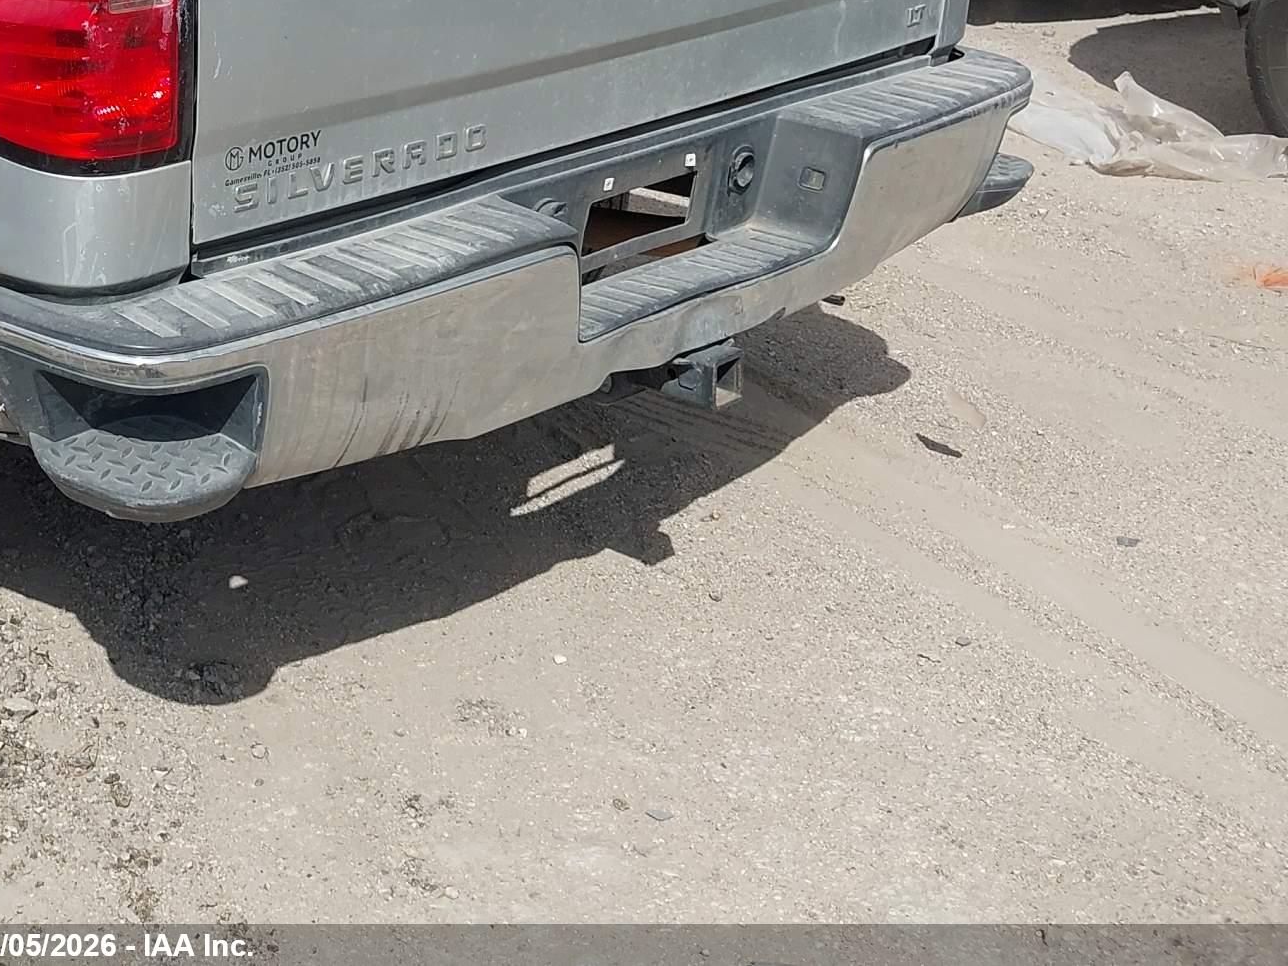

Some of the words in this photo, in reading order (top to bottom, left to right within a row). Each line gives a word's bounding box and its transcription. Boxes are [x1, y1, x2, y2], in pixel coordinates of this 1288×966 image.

[248, 129, 322, 164] MOTORY
[267, 153, 303, 167] GROUP
[232, 123, 487, 214] SILVERADO
